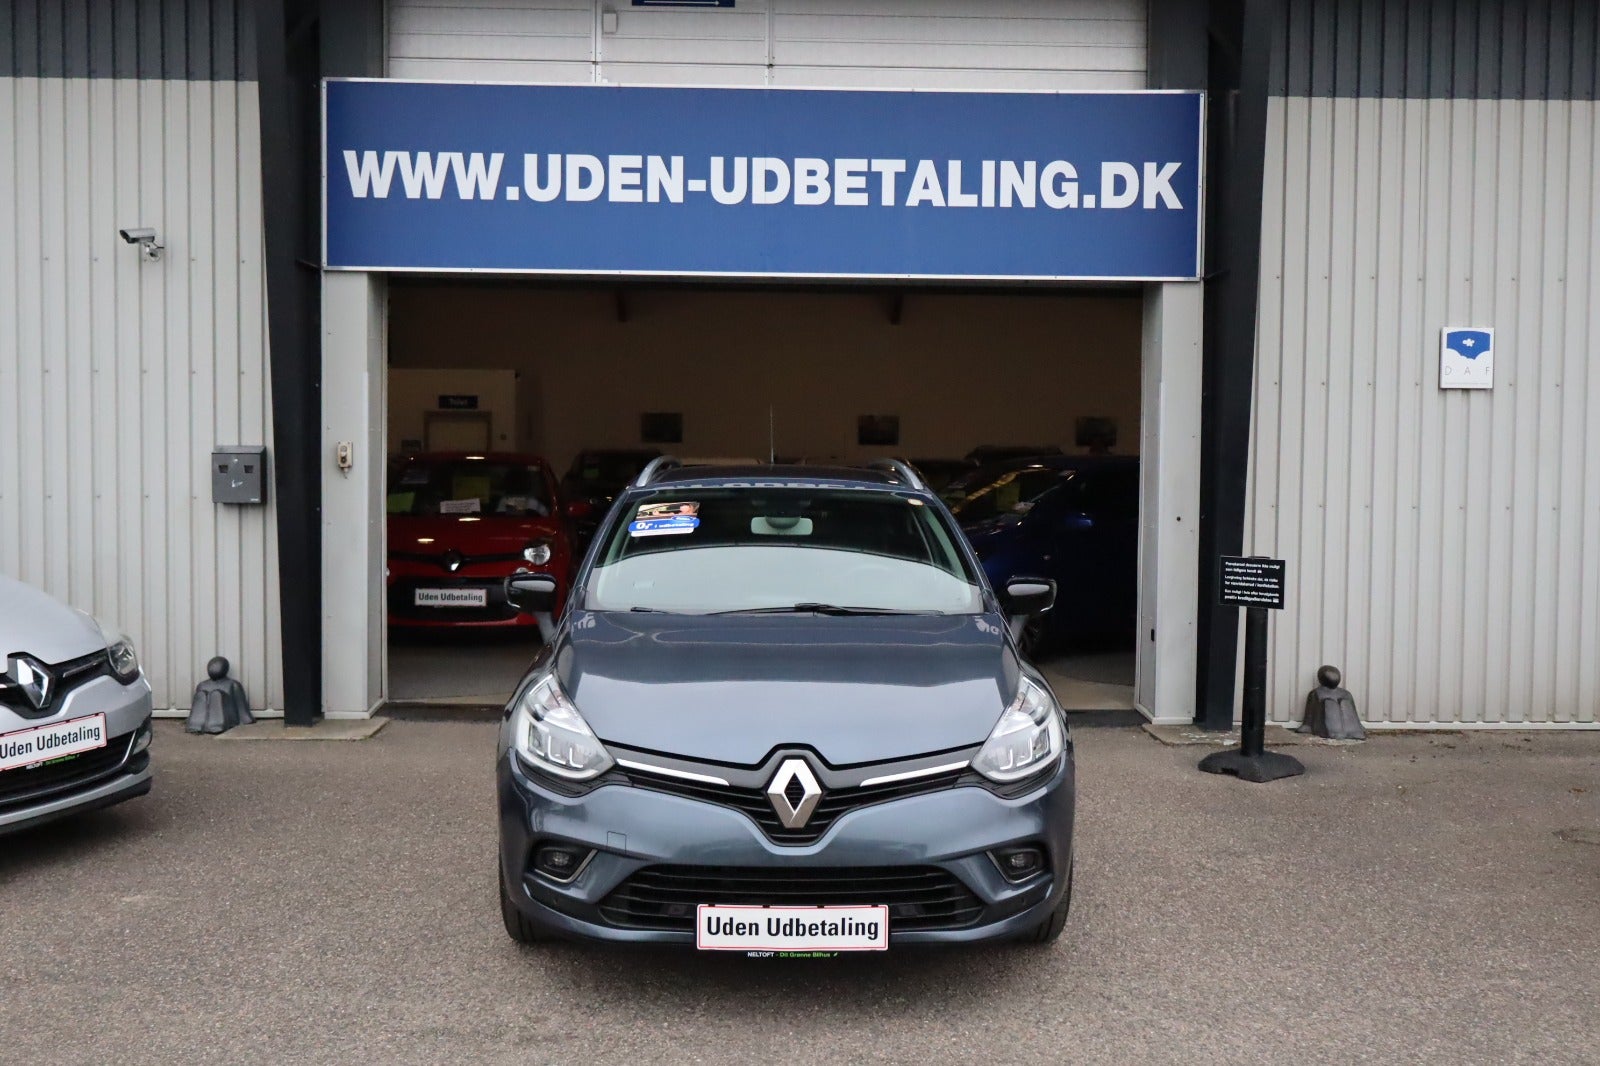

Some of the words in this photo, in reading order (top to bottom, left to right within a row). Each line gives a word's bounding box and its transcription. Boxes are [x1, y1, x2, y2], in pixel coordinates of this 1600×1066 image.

[342, 150, 1184, 210] WWW.UDEN-UDBETALING.DK
[418, 593, 439, 601] Uden
[440, 593, 483, 603] Udbetaling
[0, 742, 33, 759] Uden
[36, 726, 101, 751] Udbetaling
[707, 916, 760, 936] Uden
[767, 917, 879, 940] Udbetaling
